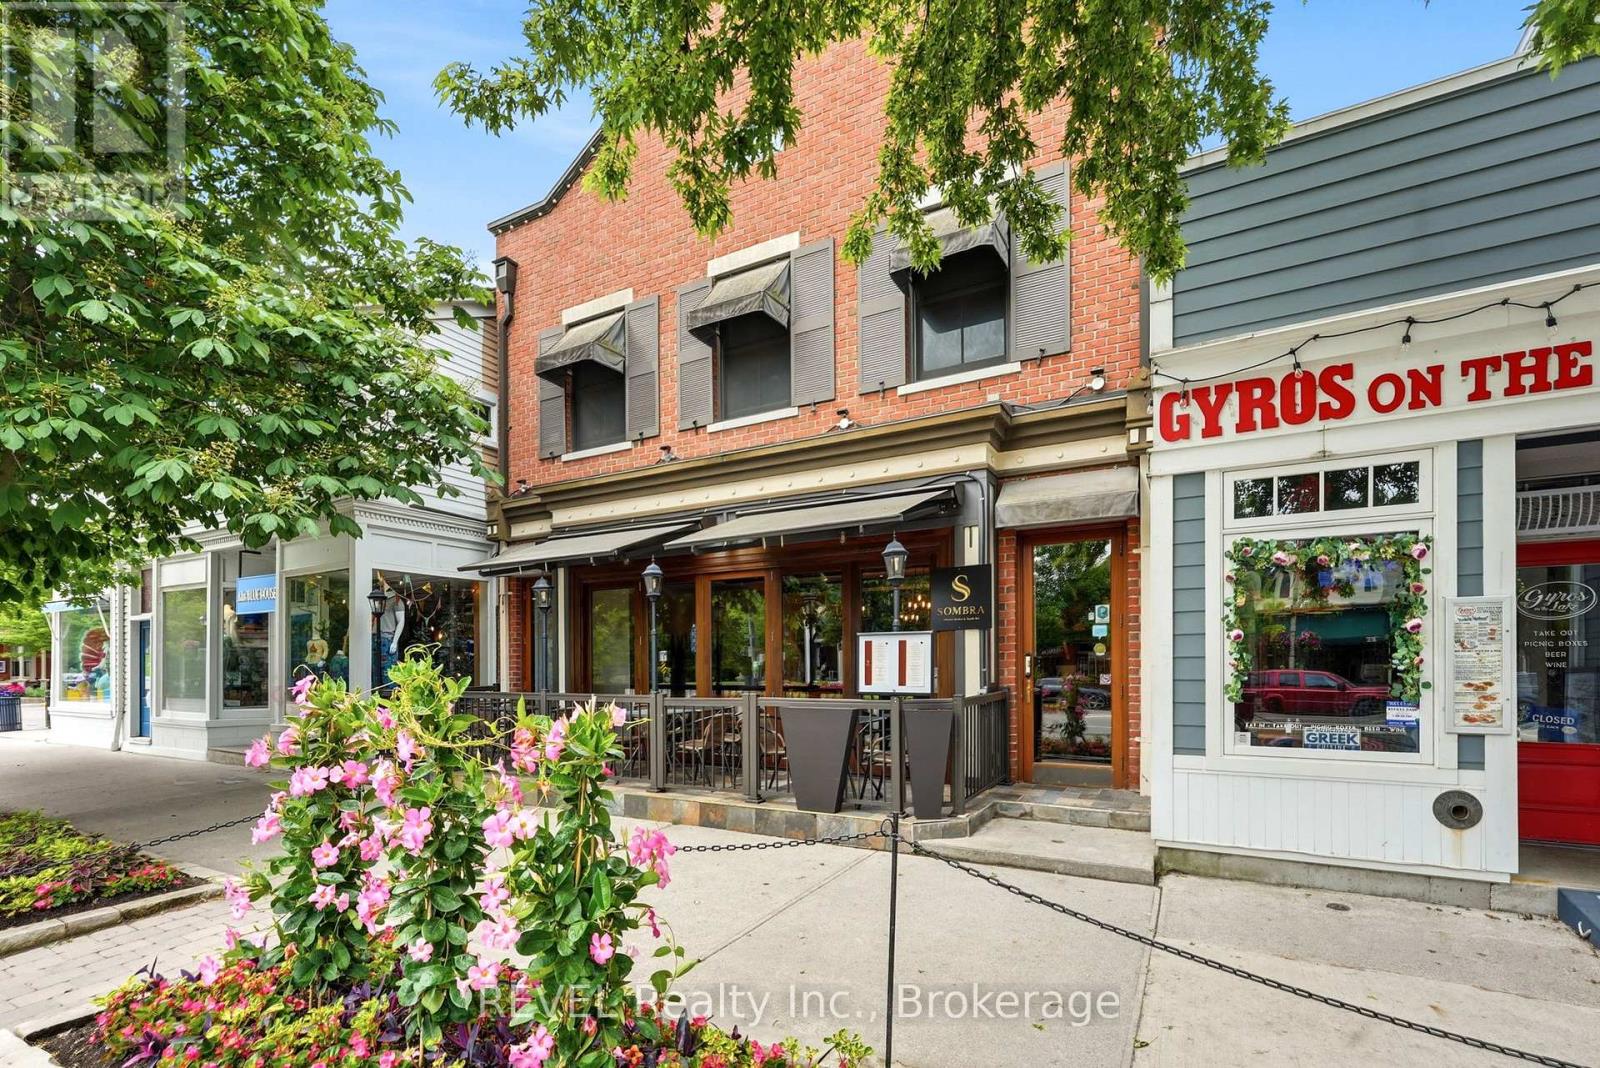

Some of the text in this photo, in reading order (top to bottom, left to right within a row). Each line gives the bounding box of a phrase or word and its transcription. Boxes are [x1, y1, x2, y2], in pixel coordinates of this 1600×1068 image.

[1158, 341, 1593, 442] GYROS ON THE
[1524, 589, 1589, 609] Gyros
[936, 605, 985, 616] SOMBRA
[1524, 640, 1555, 648] PICNIC
[1532, 713, 1575, 726] CLOSED
[1305, 732, 1359, 745] GREEK
